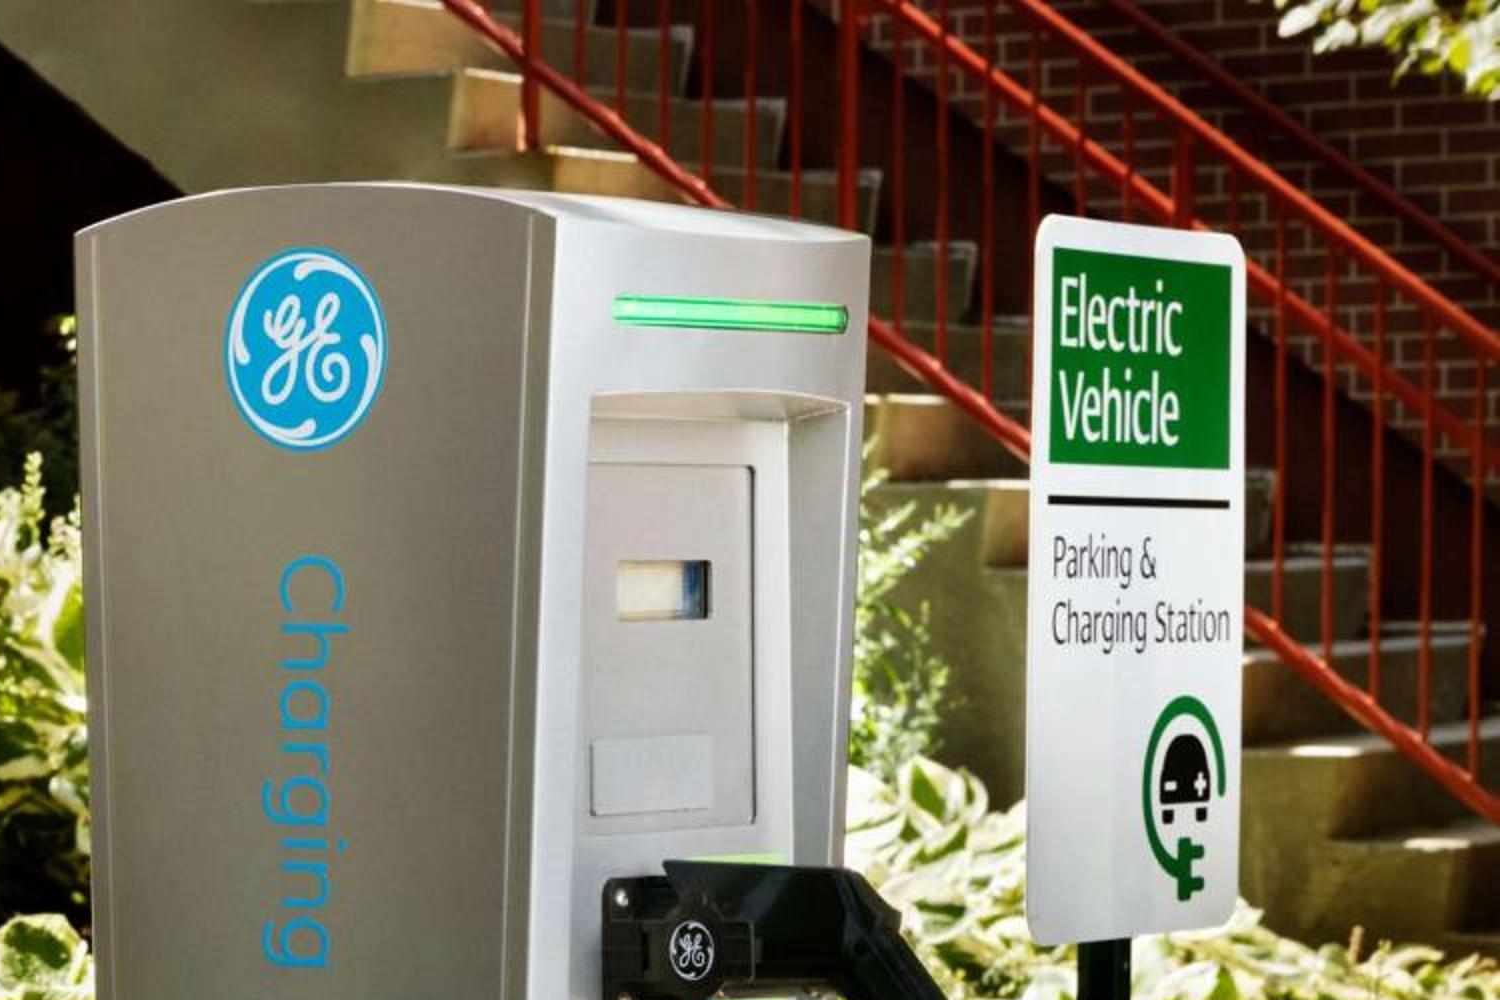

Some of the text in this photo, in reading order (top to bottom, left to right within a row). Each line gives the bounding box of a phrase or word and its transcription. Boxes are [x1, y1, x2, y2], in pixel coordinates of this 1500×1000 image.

[261, 291, 351, 405] GE
[1059, 272, 1184, 356] Electric
[1059, 367, 1181, 447] Vehicle
[1053, 533, 1157, 589] Parking &
[1052, 598, 1231, 655] Charging Station
[261, 554, 353, 969] Charging
